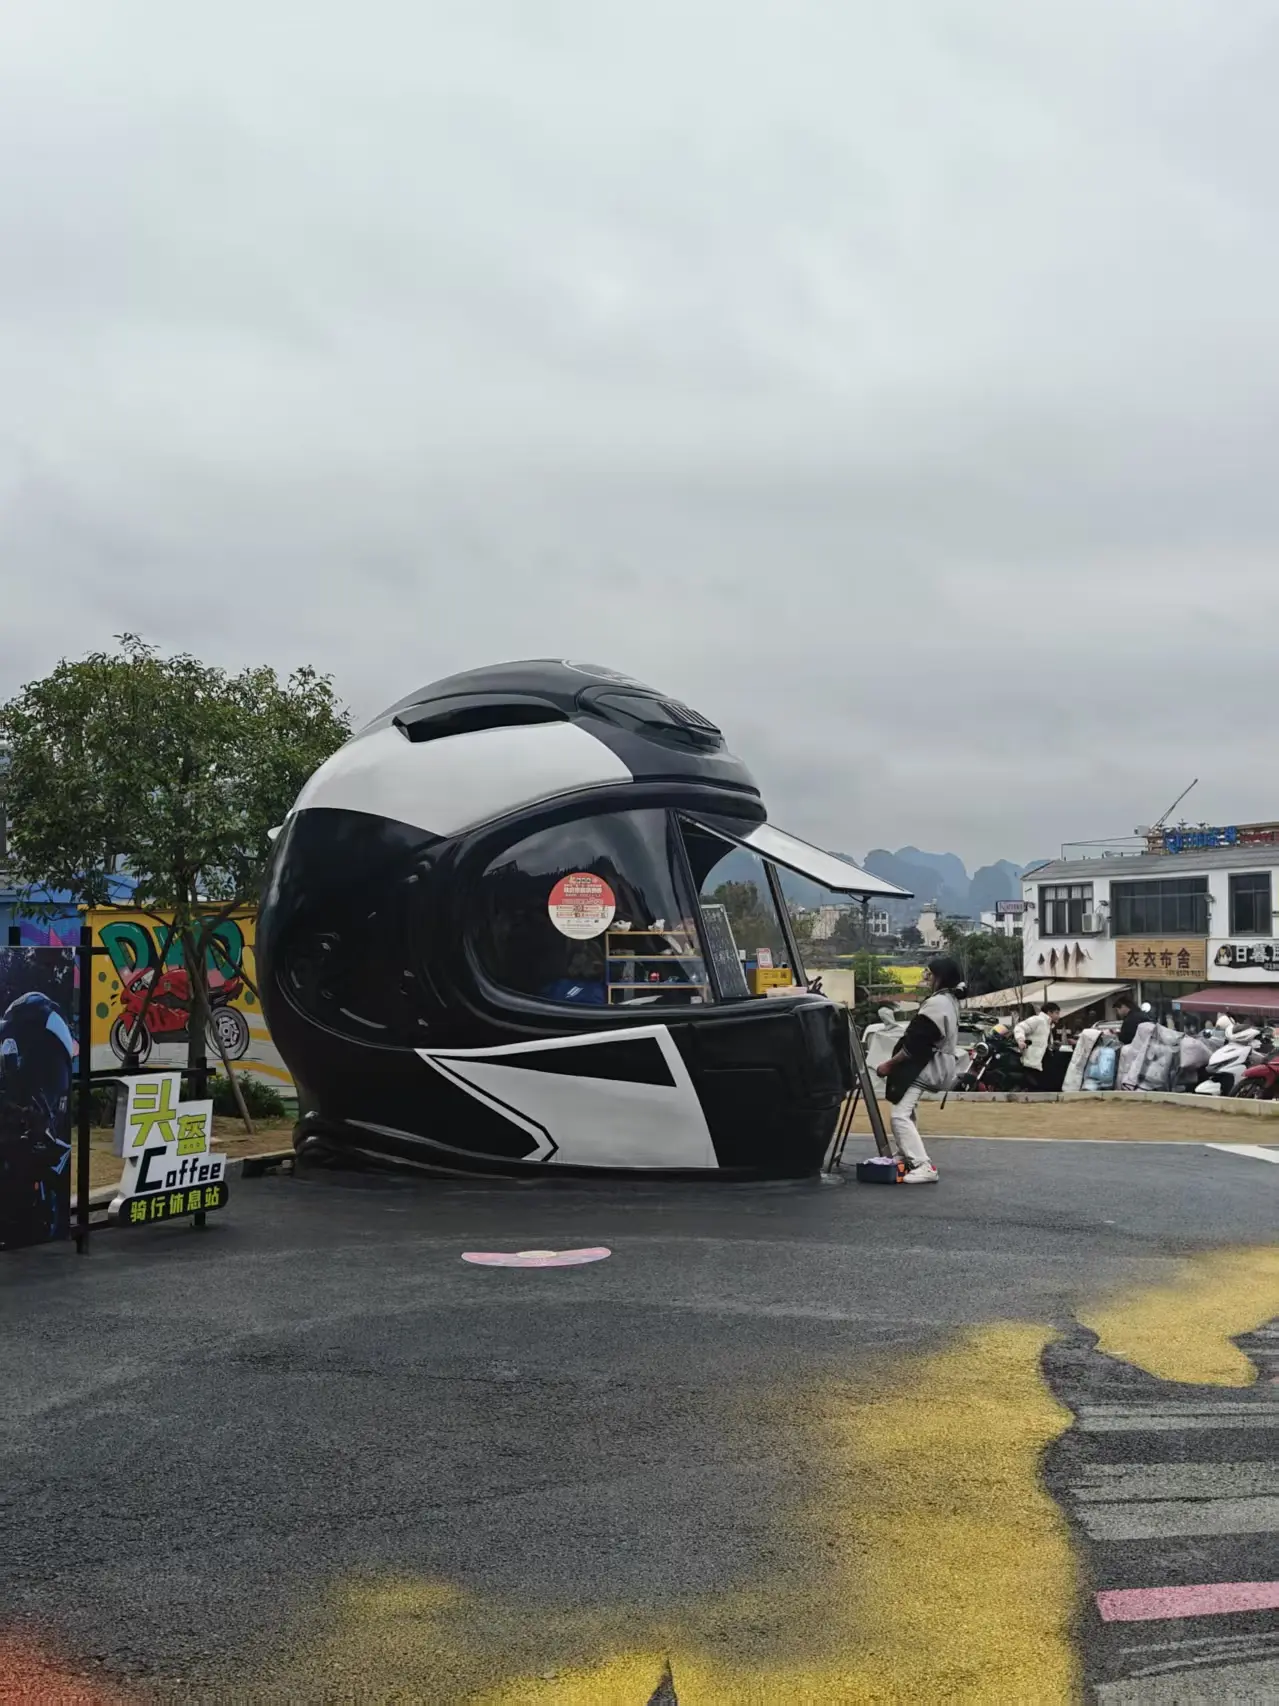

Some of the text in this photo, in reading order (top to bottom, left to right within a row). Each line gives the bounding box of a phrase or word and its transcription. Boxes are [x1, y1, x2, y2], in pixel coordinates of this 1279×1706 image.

[1126, 947, 1191, 969] 衣衣布舍
[130, 1078, 207, 1157] 头盔
[135, 1145, 221, 1194] Coffee
[130, 1187, 221, 1223] 骑行休息站
